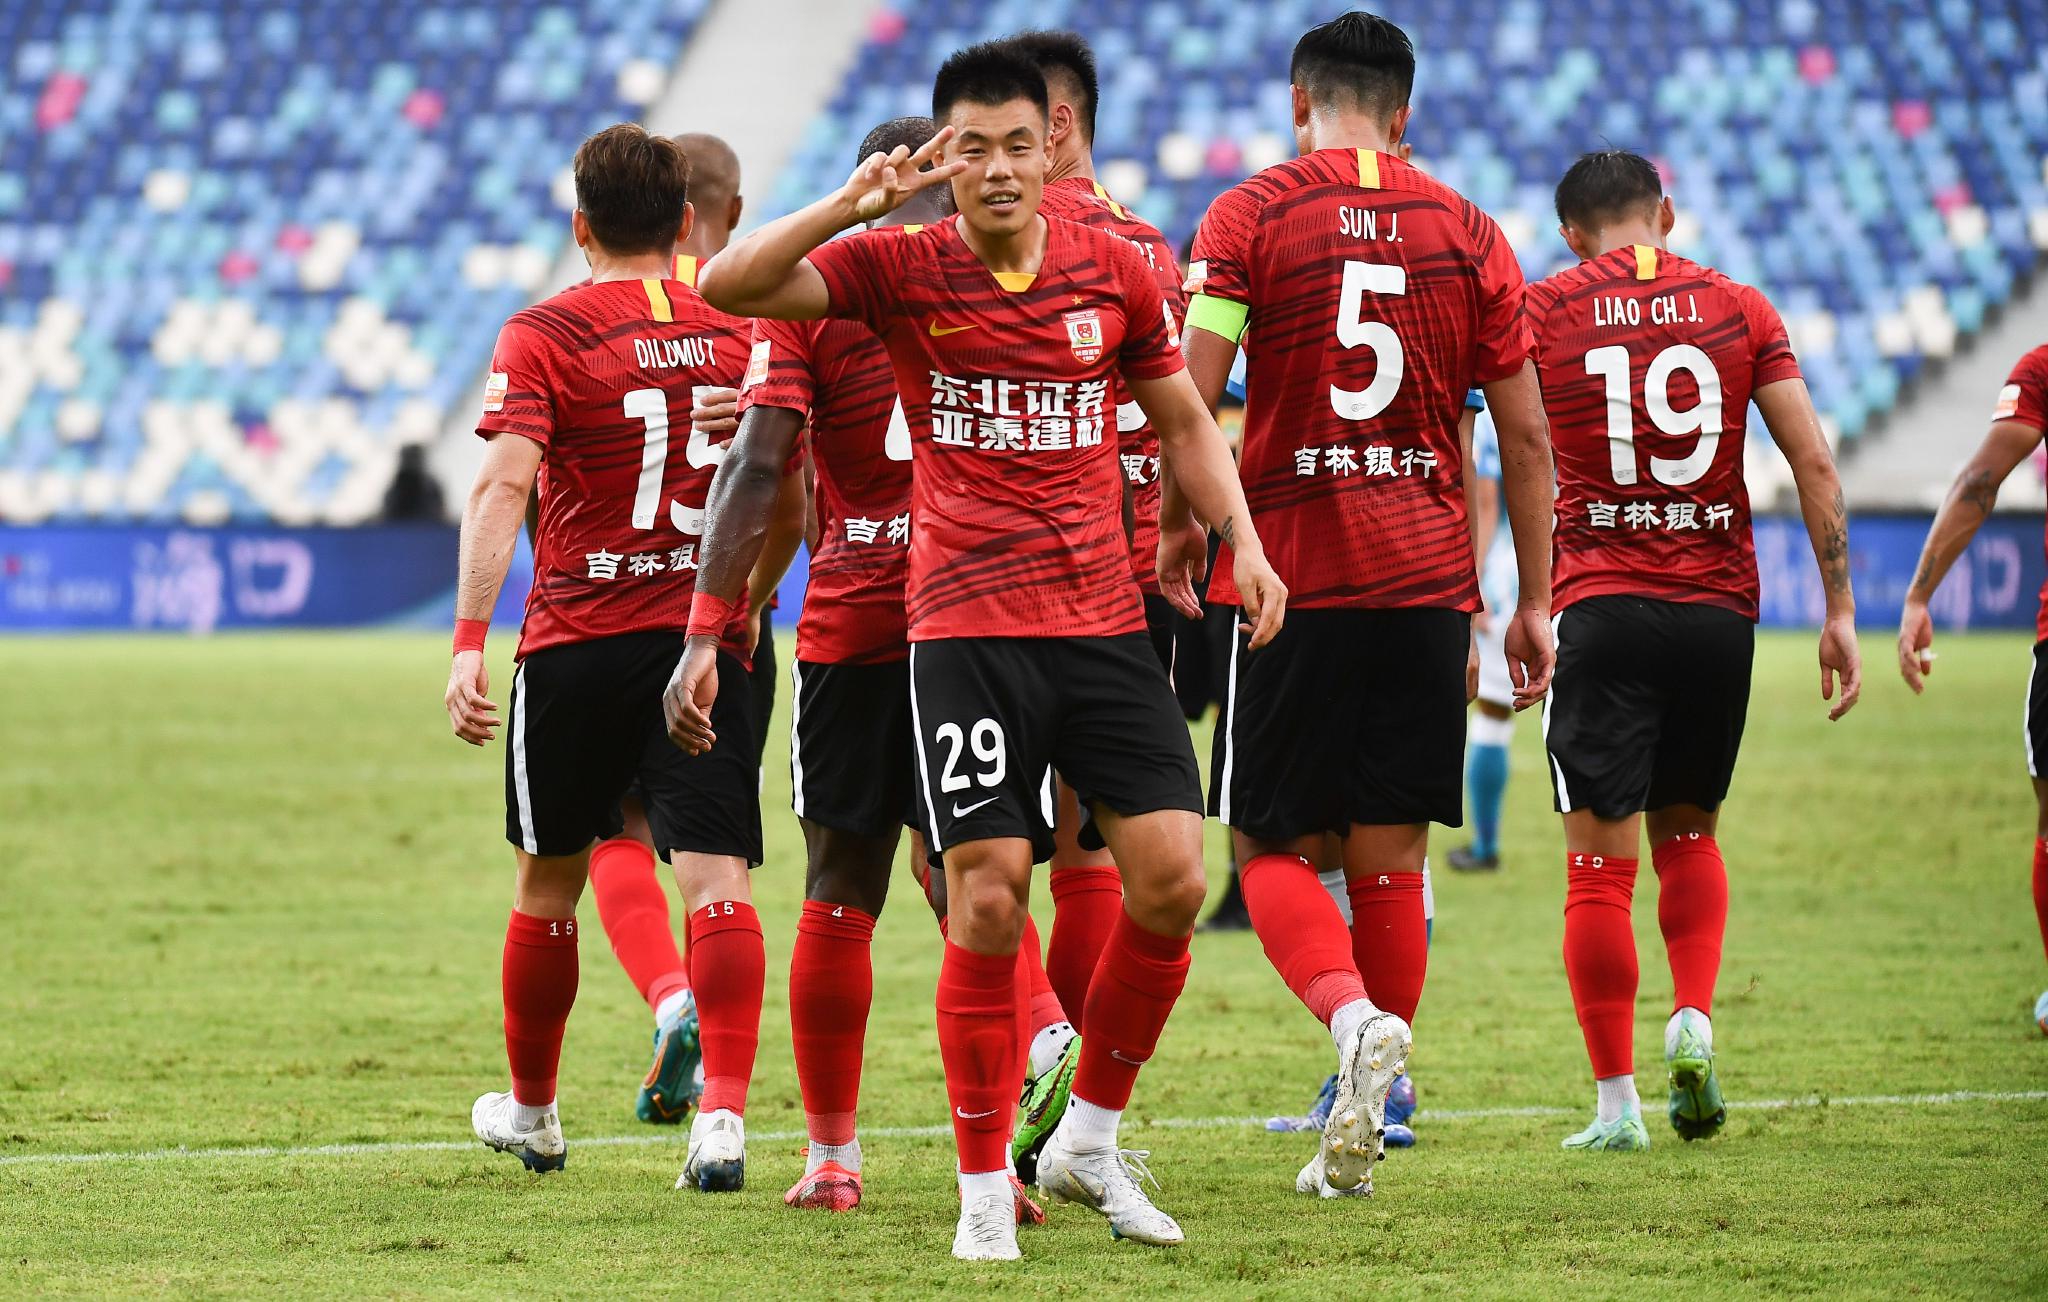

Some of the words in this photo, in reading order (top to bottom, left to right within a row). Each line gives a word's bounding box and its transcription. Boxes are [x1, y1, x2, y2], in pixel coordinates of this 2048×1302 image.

[1339, 205, 1377, 241] SUN
[1386, 212, 1404, 243] J.
[1593, 296, 1641, 327] LIAO
[1330, 259, 1406, 421] 5
[929, 370, 1108, 417] 东北证券
[1584, 343, 1724, 486] 19
[931, 408, 1105, 451] 亚泰建材
[1294, 444, 1438, 479] 吉林银行
[1586, 500, 1734, 531] 吉林银行
[935, 717, 1007, 793] 29
